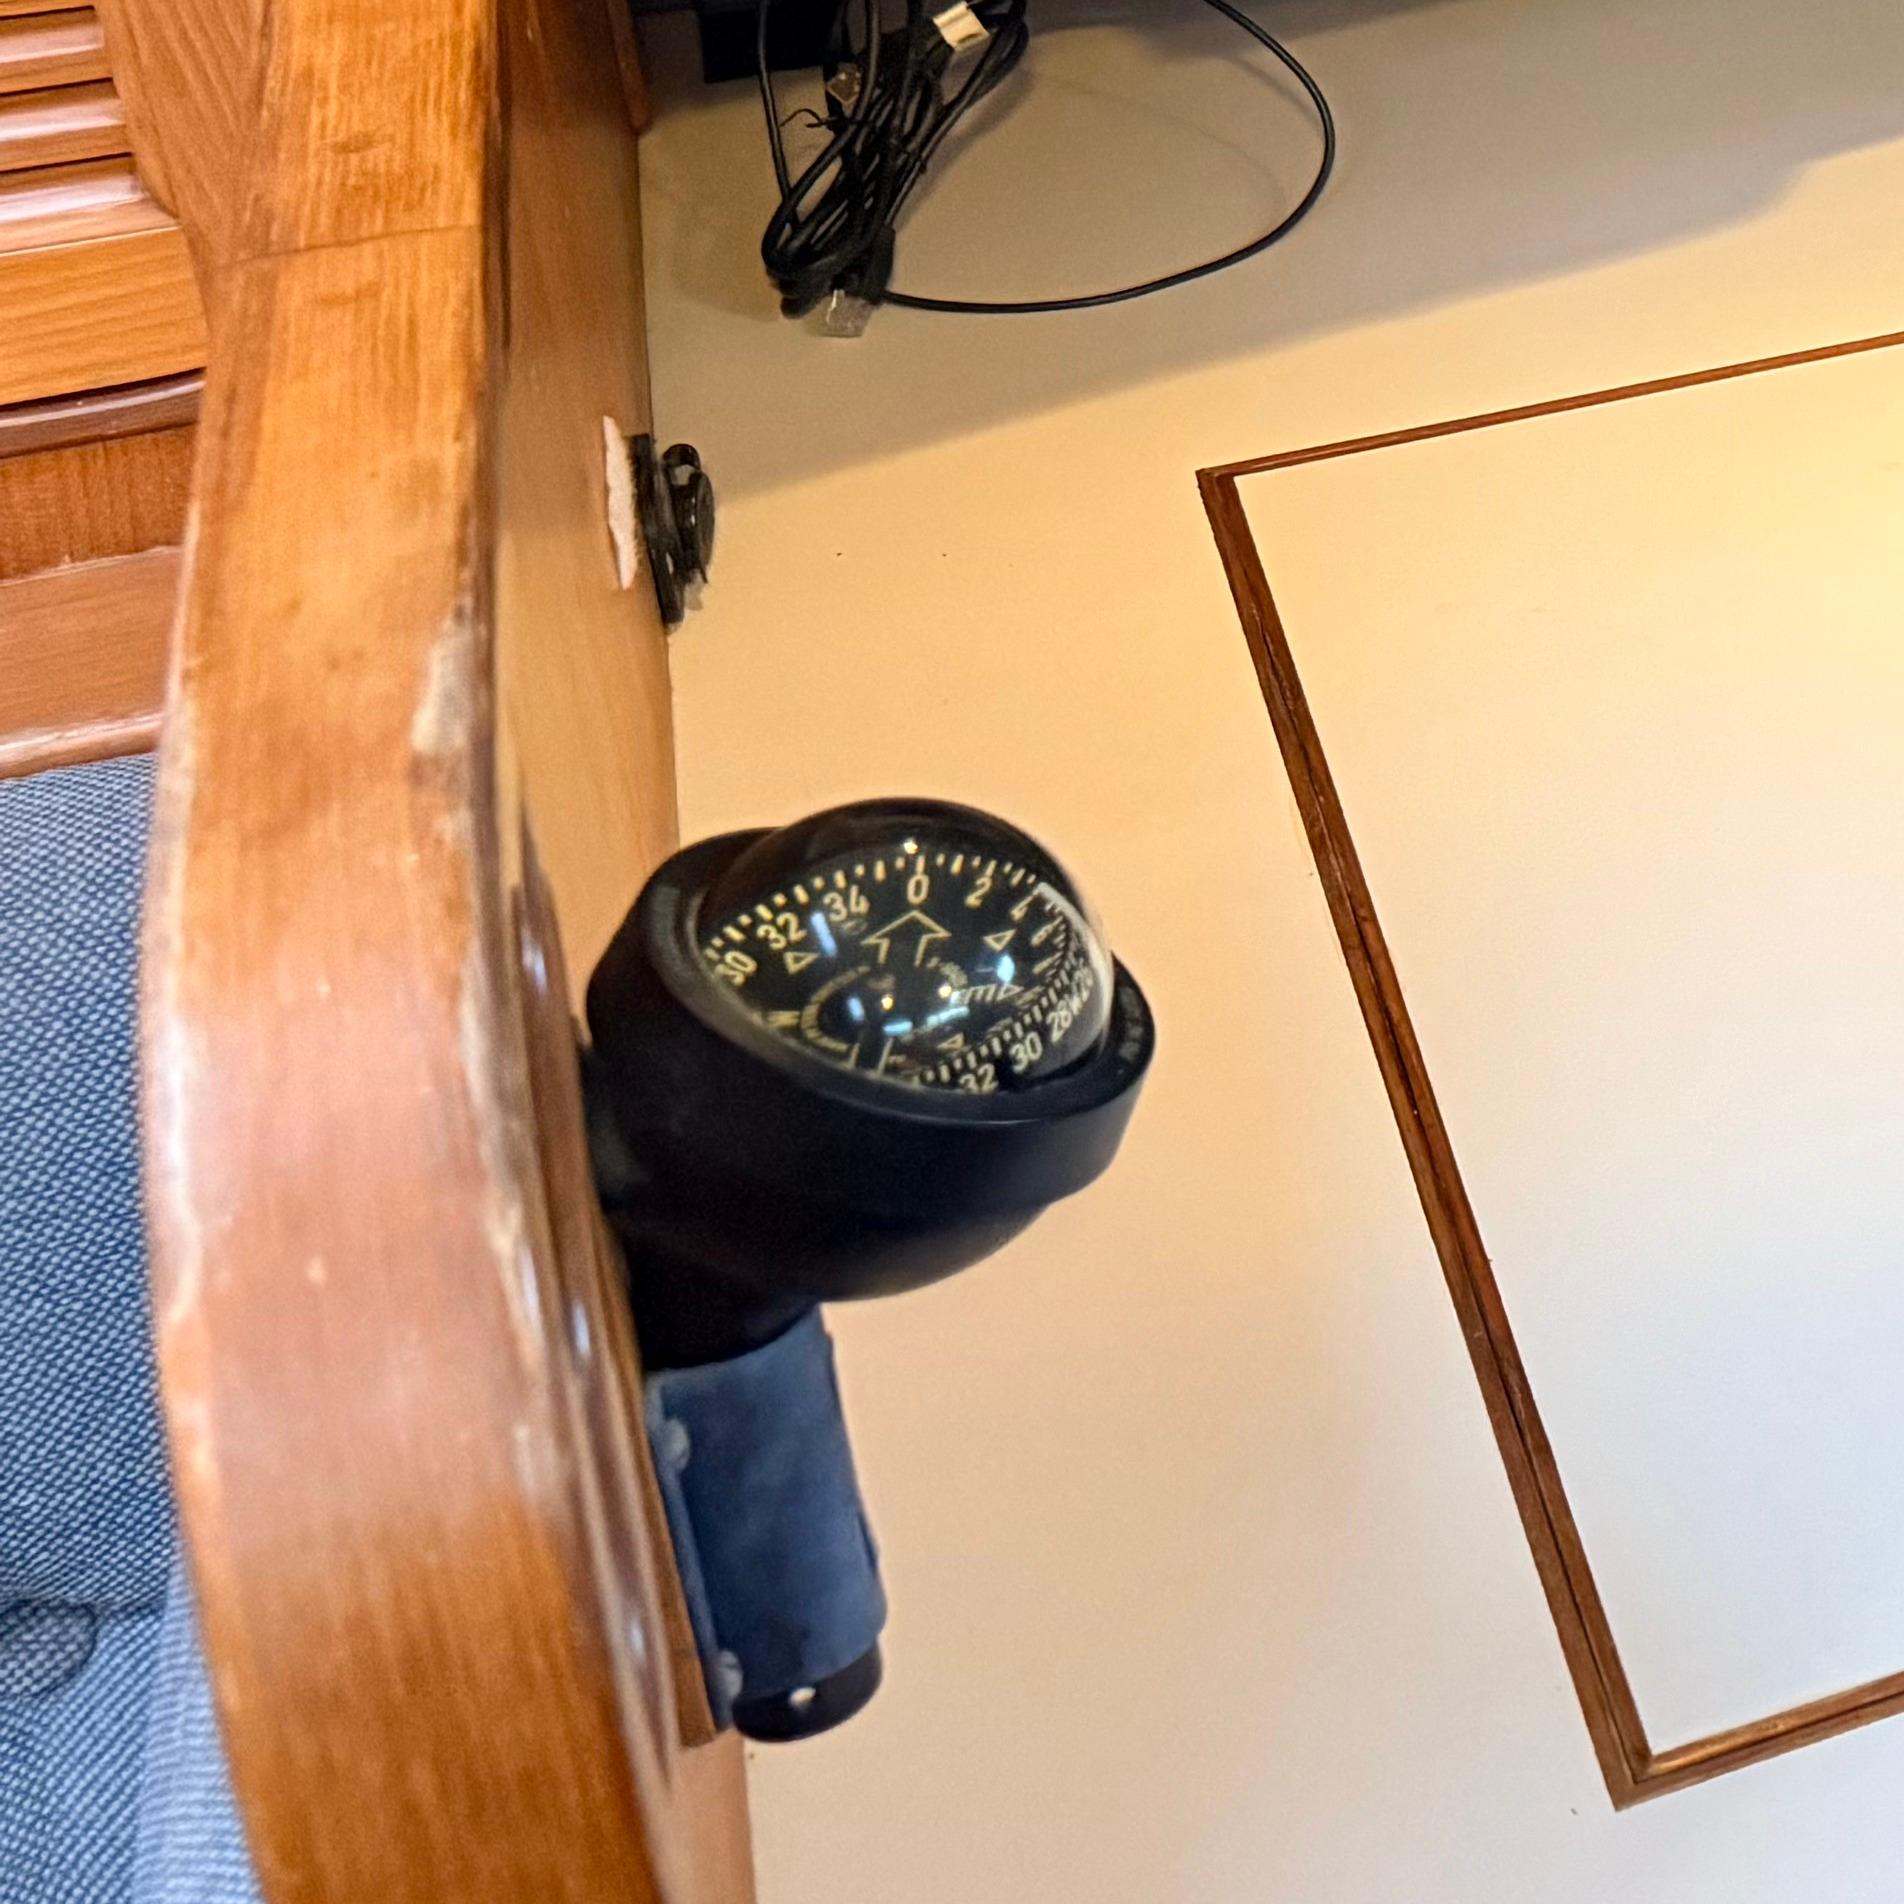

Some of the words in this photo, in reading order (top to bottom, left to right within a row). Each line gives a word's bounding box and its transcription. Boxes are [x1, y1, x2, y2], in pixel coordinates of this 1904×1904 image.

[823, 885, 870, 922] 34
[907, 874, 930, 905] 0
[965, 877, 992, 908] 2
[757, 912, 807, 950] 32
[715, 950, 758, 986] 30
[1009, 1031, 1043, 1074] 30
